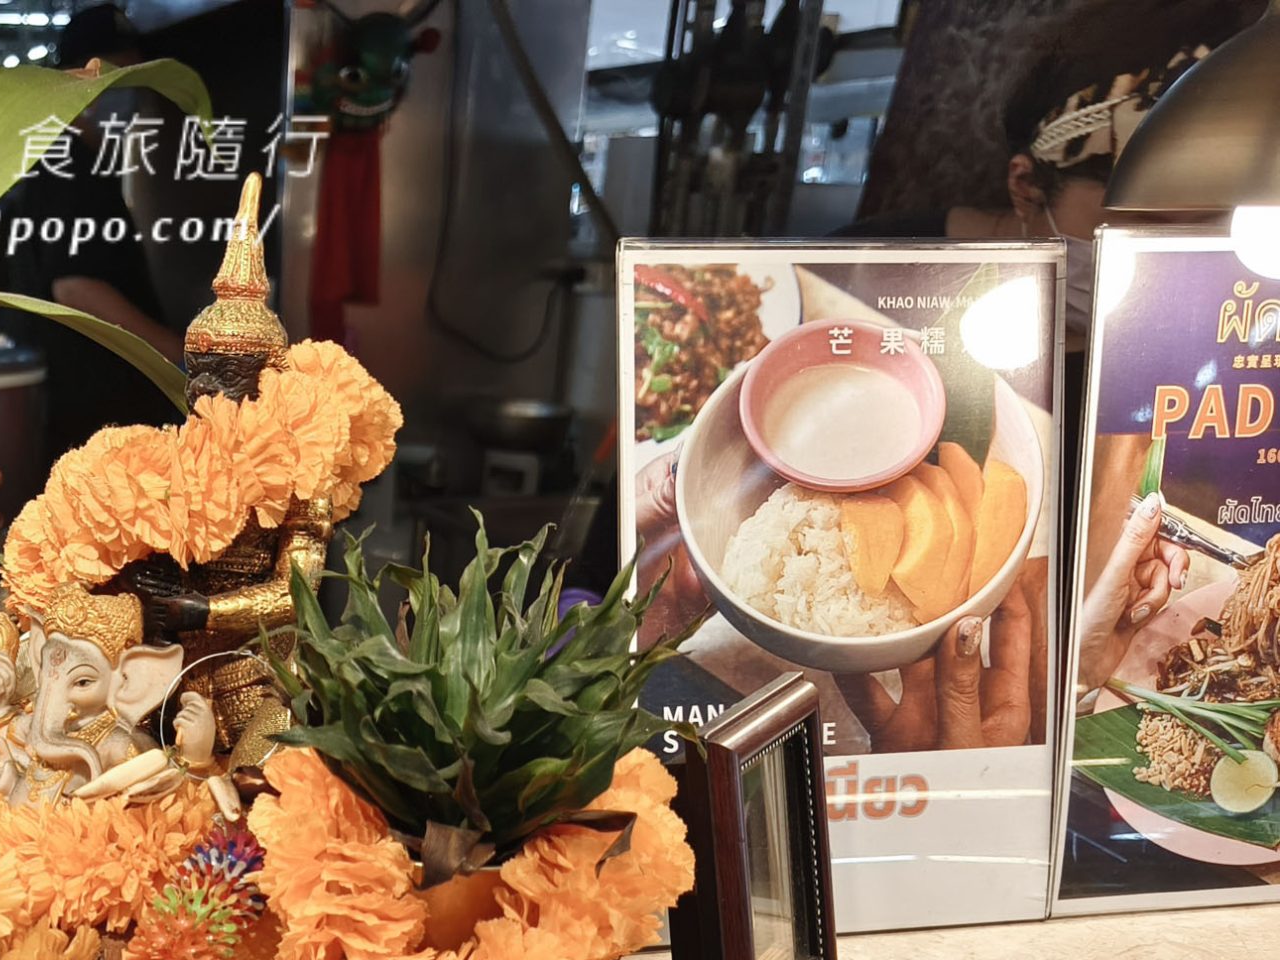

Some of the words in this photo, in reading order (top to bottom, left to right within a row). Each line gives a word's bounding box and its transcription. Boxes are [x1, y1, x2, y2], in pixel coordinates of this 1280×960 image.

[877, 296, 914, 309] KHAO
[916, 296, 951, 309] NIAW
[828, 326, 968, 355] 芒果糯
[1151, 383, 1275, 440] PAD
[1256, 448, 1280, 465] 16
[663, 704, 724, 728] MAN
[826, 760, 929, 821] นียว
